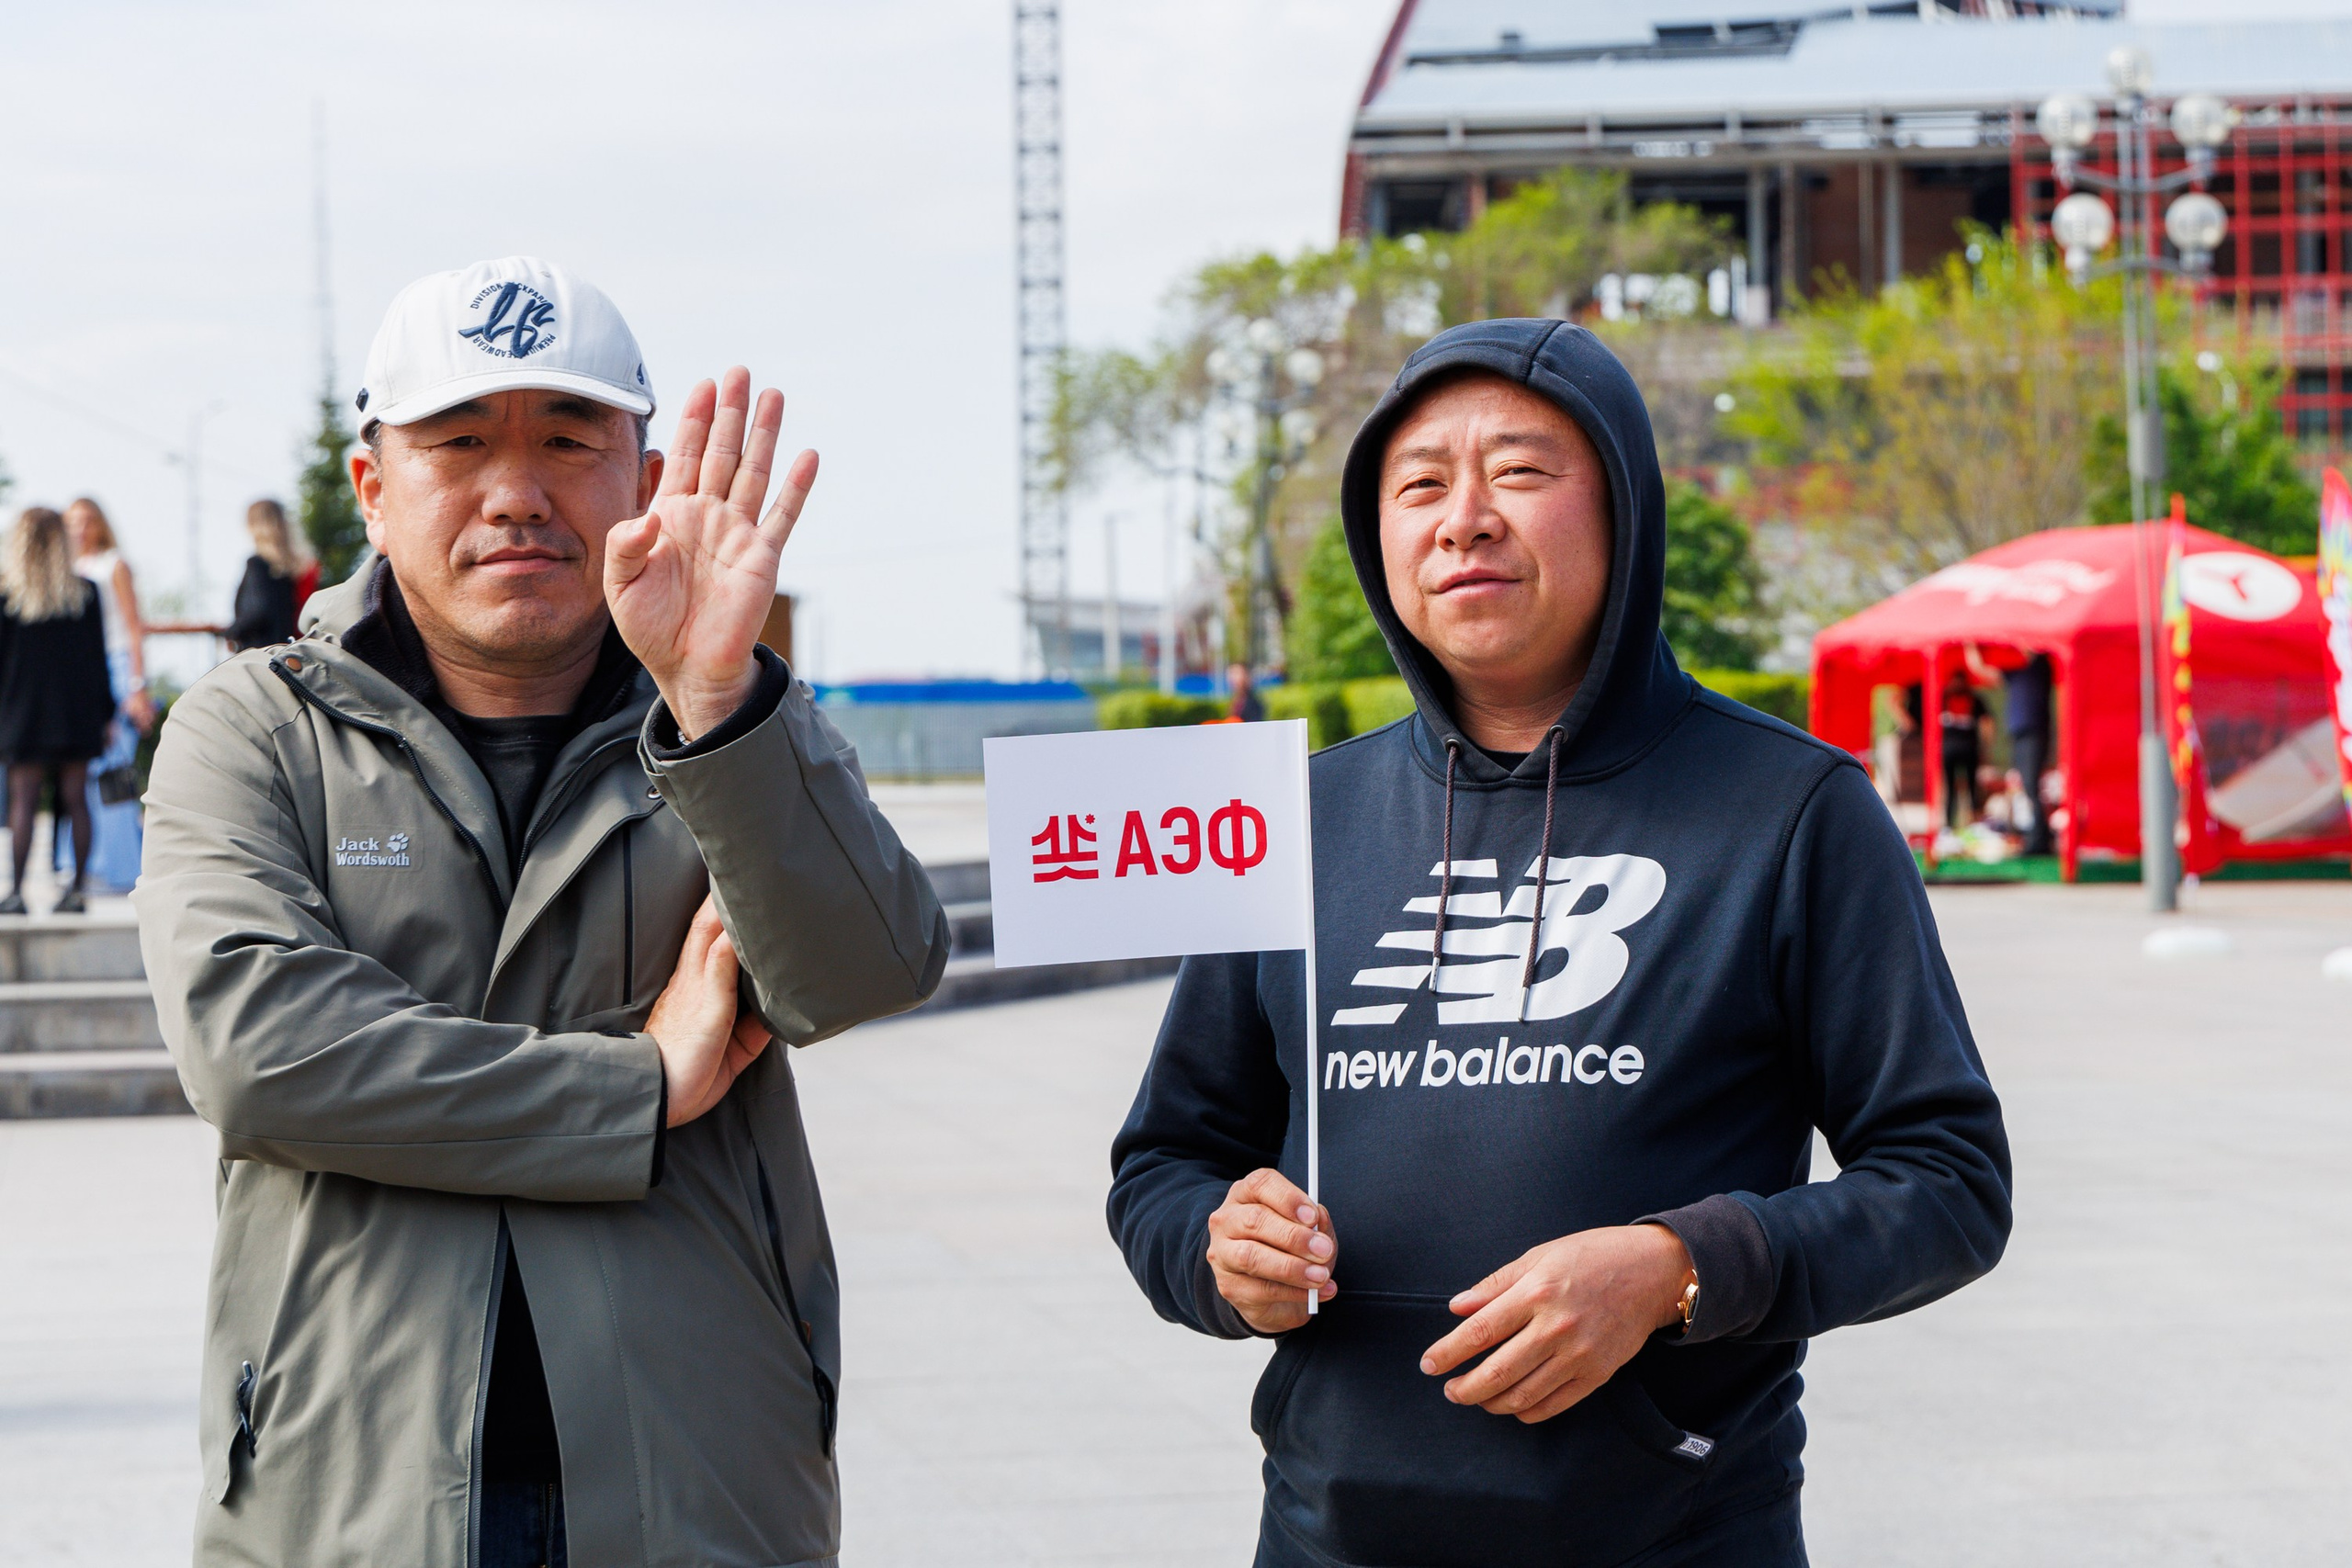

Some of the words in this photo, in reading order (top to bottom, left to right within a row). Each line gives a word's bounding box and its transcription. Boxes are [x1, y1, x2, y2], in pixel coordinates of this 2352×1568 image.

[472, 335, 514, 358] EADWEAR
[335, 837, 380, 852] Jack
[1114, 798, 1268, 878] АЭФ
[335, 852, 410, 866] Wordswoth
[1324, 1050, 1418, 1090] new
[1419, 1036, 1645, 1088] balance
[1687, 1440, 1709, 1455] 1906
